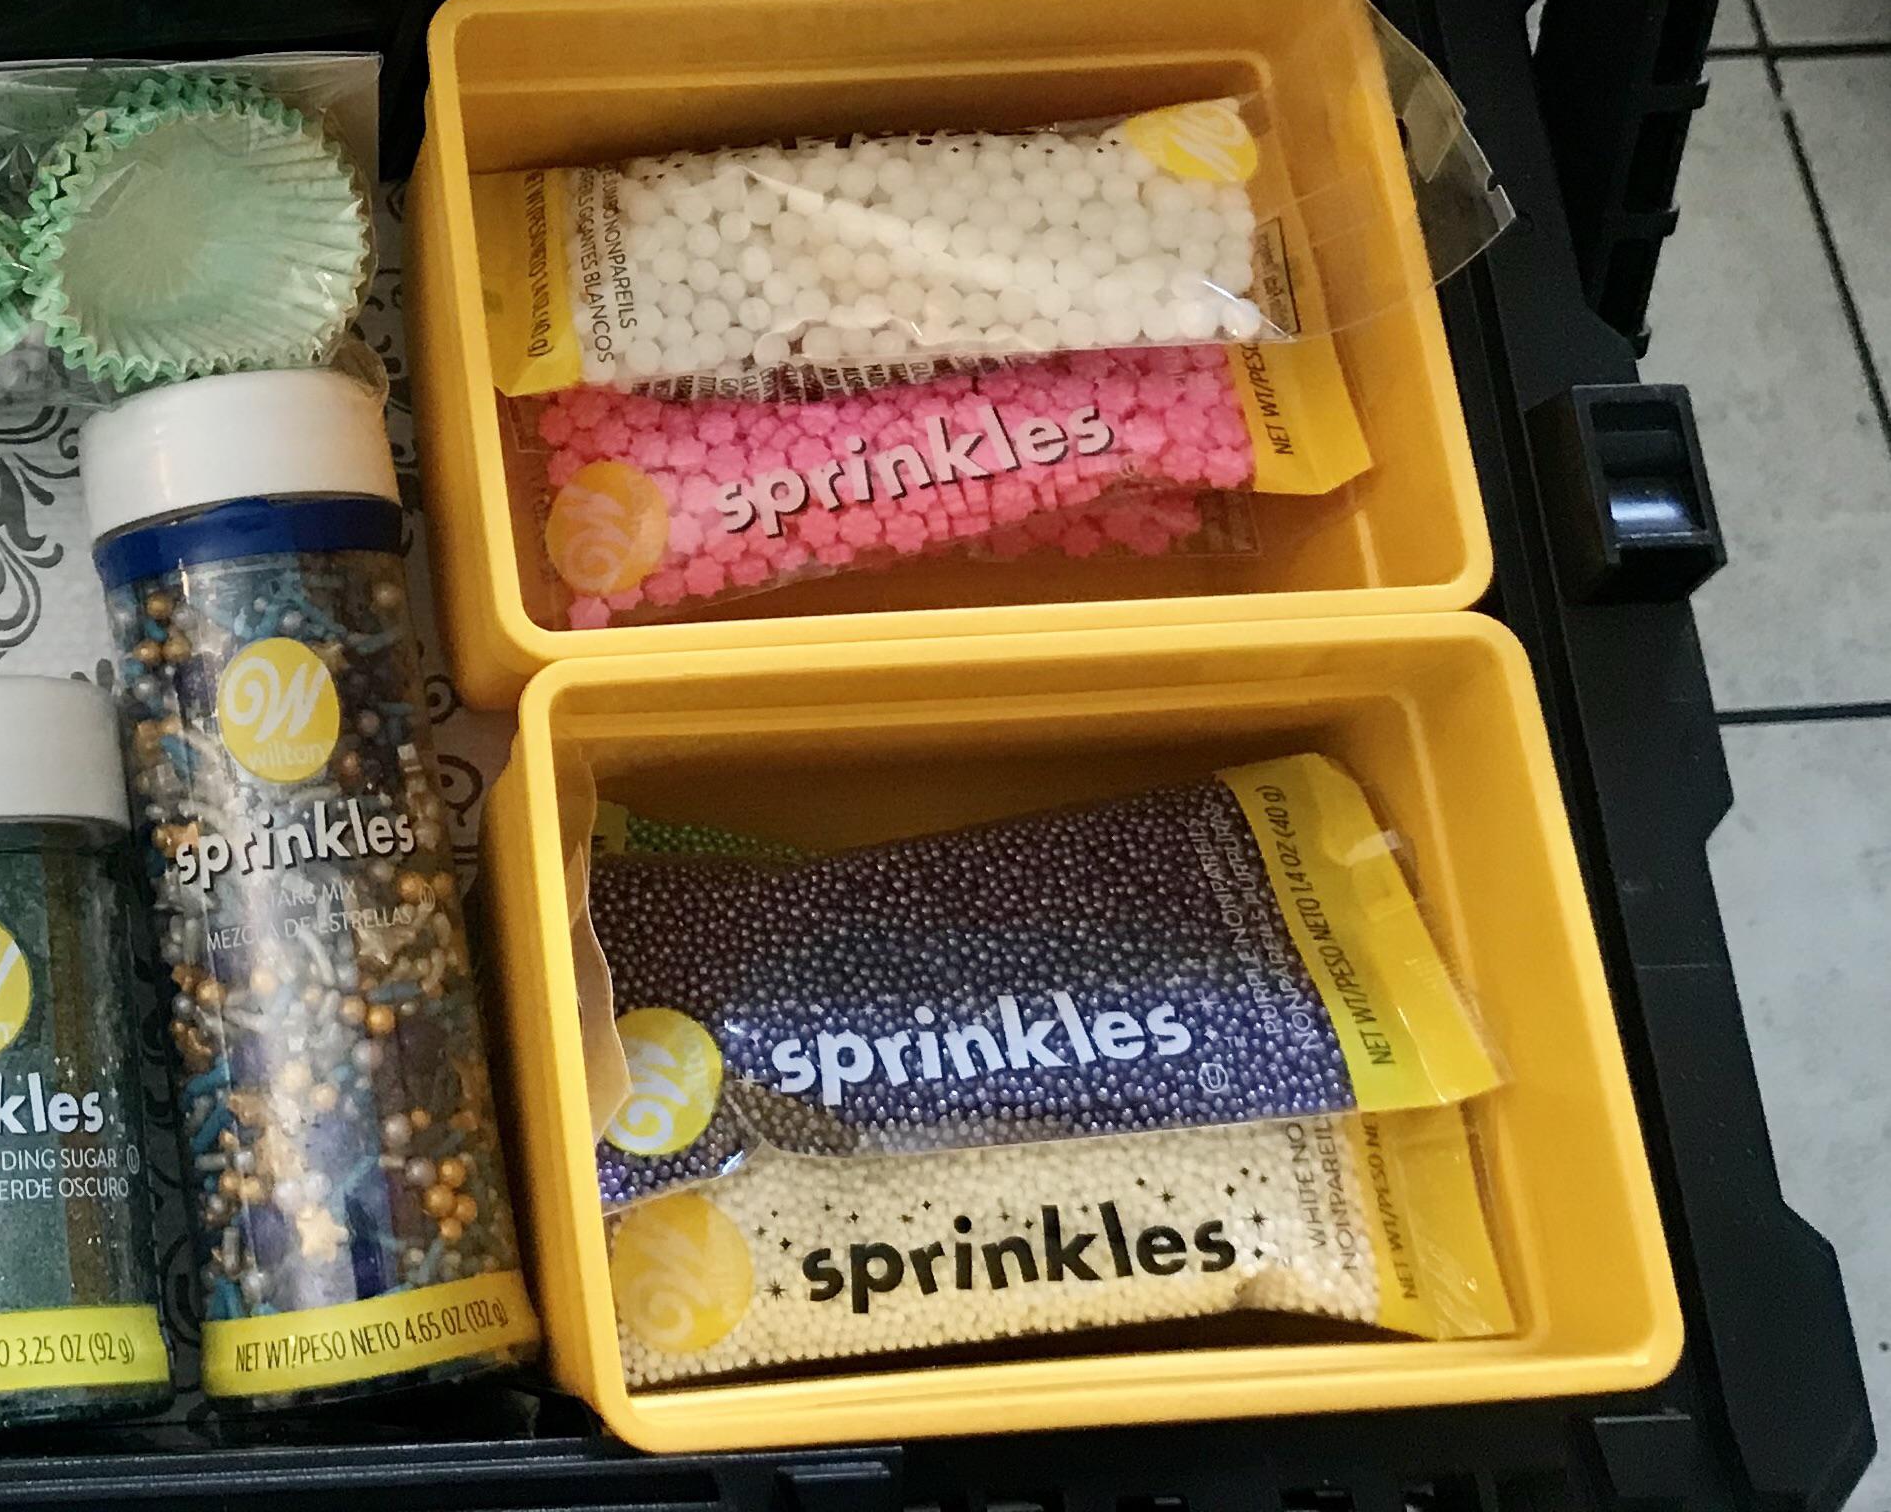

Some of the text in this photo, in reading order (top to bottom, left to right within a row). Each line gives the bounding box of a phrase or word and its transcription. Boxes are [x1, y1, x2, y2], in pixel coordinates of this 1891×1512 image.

[603, 217, 638, 330] NONPAREILS
[583, 271, 615, 363] BLANCOS
[714, 403, 1115, 539] sprinkles
[1265, 423, 1295, 456] NET
[247, 742, 326, 769] wilton
[176, 797, 417, 890] sprinkles
[1277, 839, 1302, 868] OZ
[316, 907, 413, 935] ESTRELLAS
[322, 879, 358, 903] MIX
[1188, 816, 1284, 1037] PURPLE NONPAREILS
[1296, 897, 1333, 942] NETO
[1318, 944, 1378, 1026] WT/PESO
[770, 989, 1197, 1107] sprinkles
[1358, 1028, 1396, 1067] NET
[57, 1175, 130, 1199] OSCURO
[60, 1145, 118, 1170] SUGAR
[1295, 1171, 1327, 1249] WHITE
[1368, 1154, 1420, 1300] NET WT/PESO
[801, 1198, 1239, 1315] sprinkles
[16, 1334, 56, 1367] 3.25
[59, 1332, 87, 1364] OZ
[235, 1341, 264, 1375] NET
[265, 1330, 348, 1370] WT/PESO
[349, 1319, 402, 1357] NETO
[403, 1308, 442, 1347] 4.65
[441, 1304, 467, 1337] OZ
